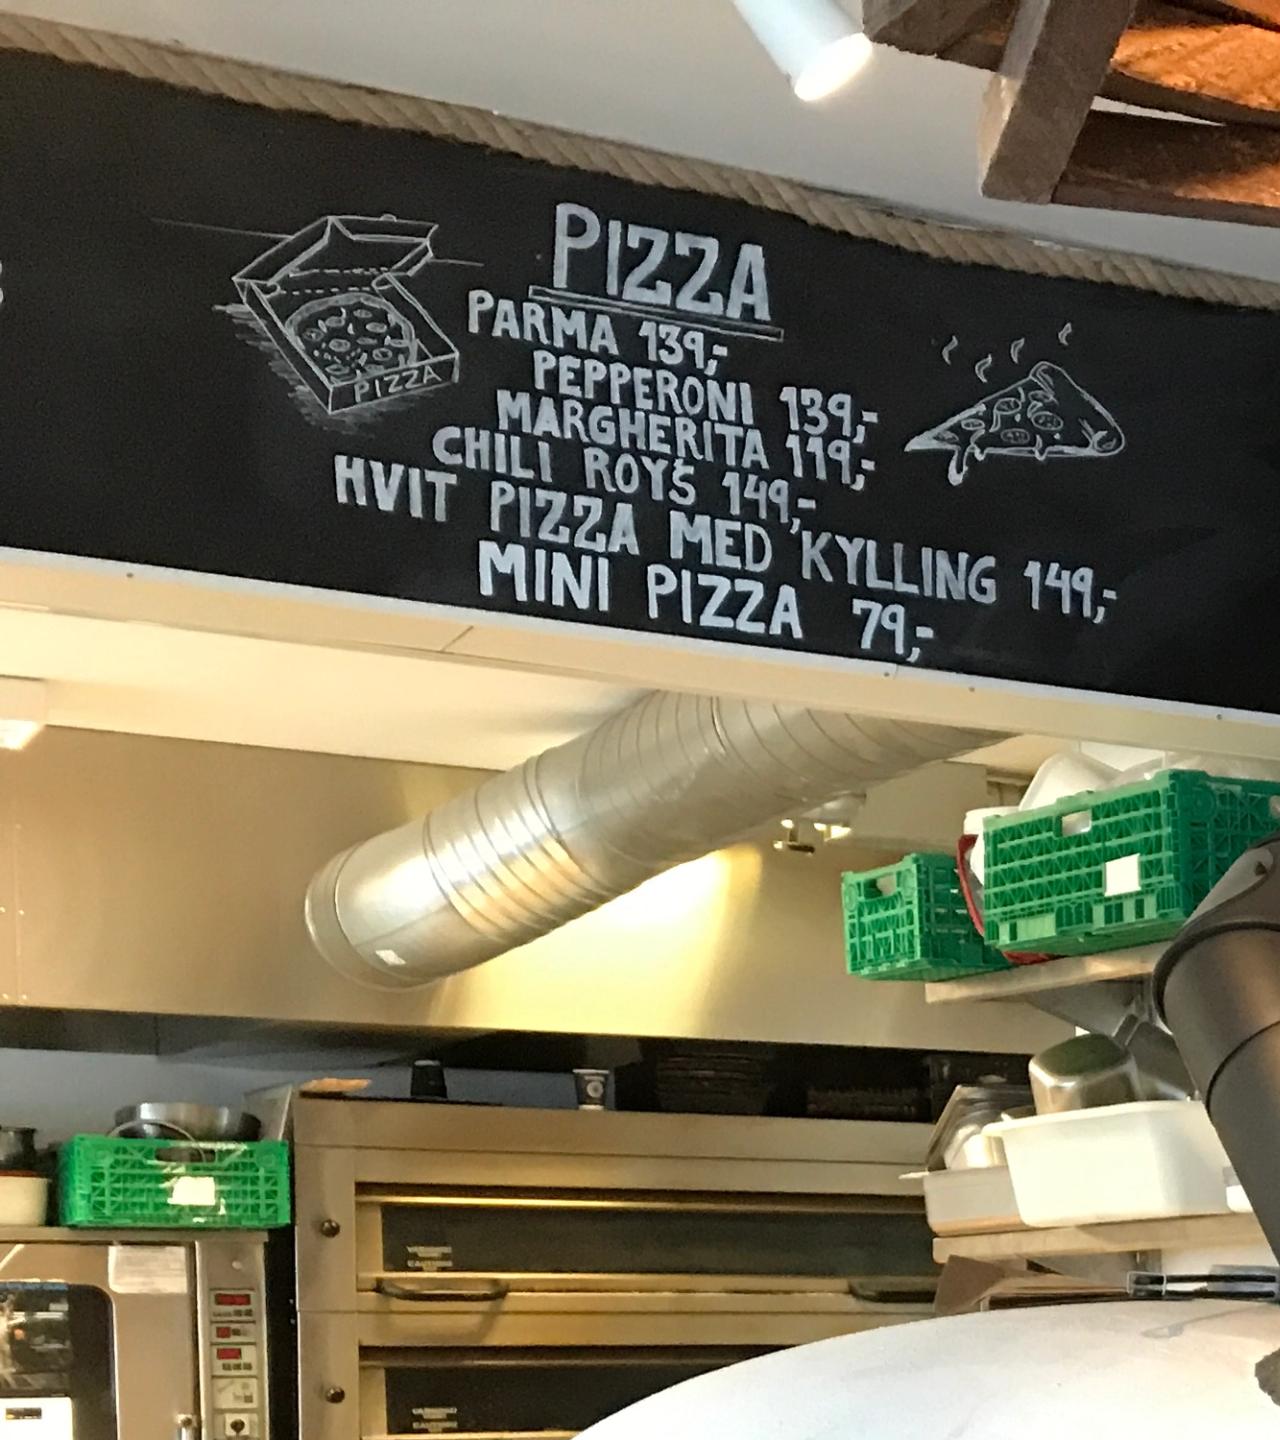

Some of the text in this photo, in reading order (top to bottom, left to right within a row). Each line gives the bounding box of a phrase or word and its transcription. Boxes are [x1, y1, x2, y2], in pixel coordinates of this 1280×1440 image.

[553, 201, 771, 322] PIZZA
[353, 365, 443, 403] PIZZA
[468, 289, 729, 376] PARMA 139,-
[497, 389, 876, 491] MARGHERITA 119,-
[532, 349, 879, 444] PEPPERONI 139,-
[432, 426, 553, 482] CHILI
[722, 471, 816, 533] 149,-
[334, 454, 1118, 625] HVIT PIZZA MED KYLLING 149,-
[477, 539, 935, 662] MINI PIZZA 79,-
